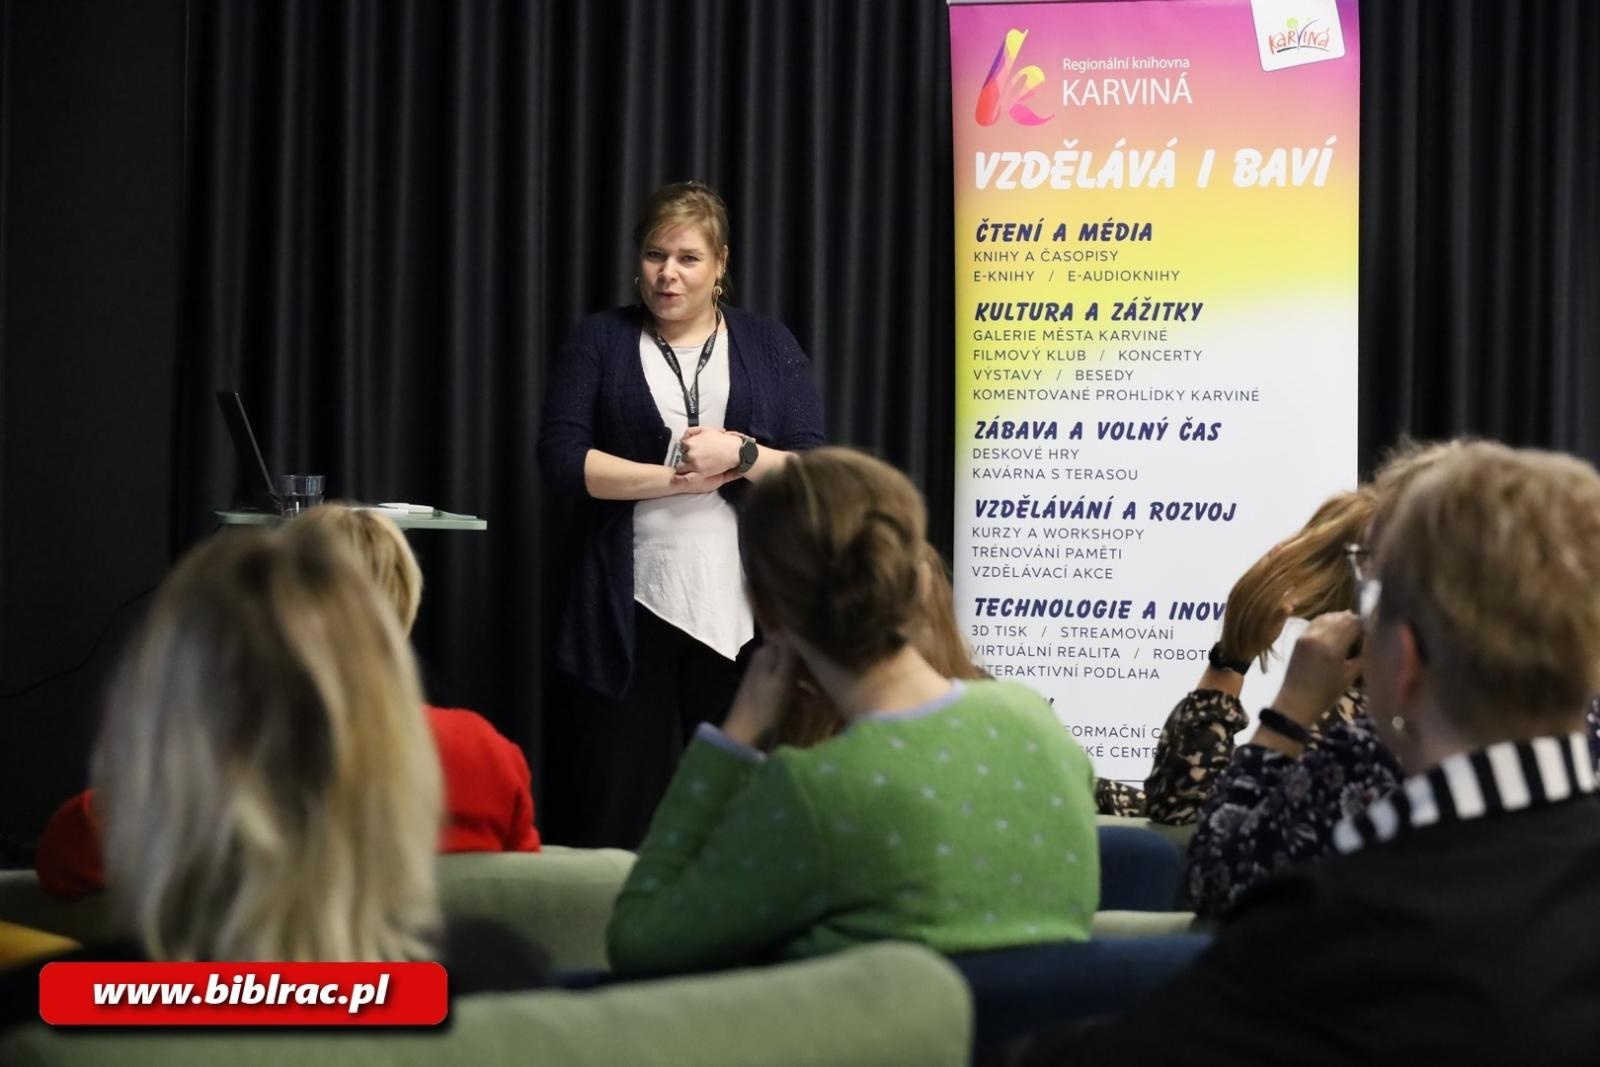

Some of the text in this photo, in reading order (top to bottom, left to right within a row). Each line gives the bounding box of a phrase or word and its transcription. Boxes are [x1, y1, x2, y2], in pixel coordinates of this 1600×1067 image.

[1063, 56, 1190, 73] Regionální knihovna
[1063, 72, 1192, 106] KARVINÁ
[975, 135, 1337, 190] VZDĚLÁVÁ I BAVÍ
[975, 216, 1153, 242] ČTENÍ A MÉDIA
[974, 247, 1118, 263] KNIHY A ČASOPISY
[974, 270, 1035, 283] E-KNIHY
[1068, 269, 1180, 282] E-AUDIOKNIHY
[975, 296, 1204, 323] KULTURA A ZÁŽITKY
[973, 327, 1168, 342] GALERIE MĚSTA KARVINÉ
[973, 347, 1041, 362] FILMOVÝ
[1047, 349, 1086, 362] KLUB
[1118, 349, 1203, 362] KONCERTY
[973, 366, 1042, 381] VÝSTAVY
[1075, 369, 1134, 382] BESEDY
[973, 386, 1260, 402] KOMENTOVANÉ PROHLÍDKY KARVINÉ
[975, 415, 1222, 442] ZÁBAVA A VOLNÝ ČAS
[972, 445, 1079, 460] DESKOVÉ HRY
[972, 465, 1138, 481] KAVÁRNA S TERASOU
[975, 495, 1237, 522] VZDĚLÁVÁNÍ A ROZVOJ
[972, 527, 1144, 540] KURZY A WORKSHOPY
[972, 543, 1122, 560] TRÉNOVÁNÍ PAMĚTI
[972, 563, 1113, 580] VZDĚLÁVACÍ AKCE
[975, 598, 1226, 621] TECHNOLOGIE A INOV
[971, 625, 989, 637] 3D
[994, 625, 1027, 637] TISK
[1060, 626, 1174, 640] STREAMOVÁNÍ
[1057, 647, 1121, 659] REALITA
[1153, 649, 1211, 661] ROBOT
[1083, 666, 1160, 679] PODLAHA
[1064, 723, 1146, 738] ORMAČNÍ
